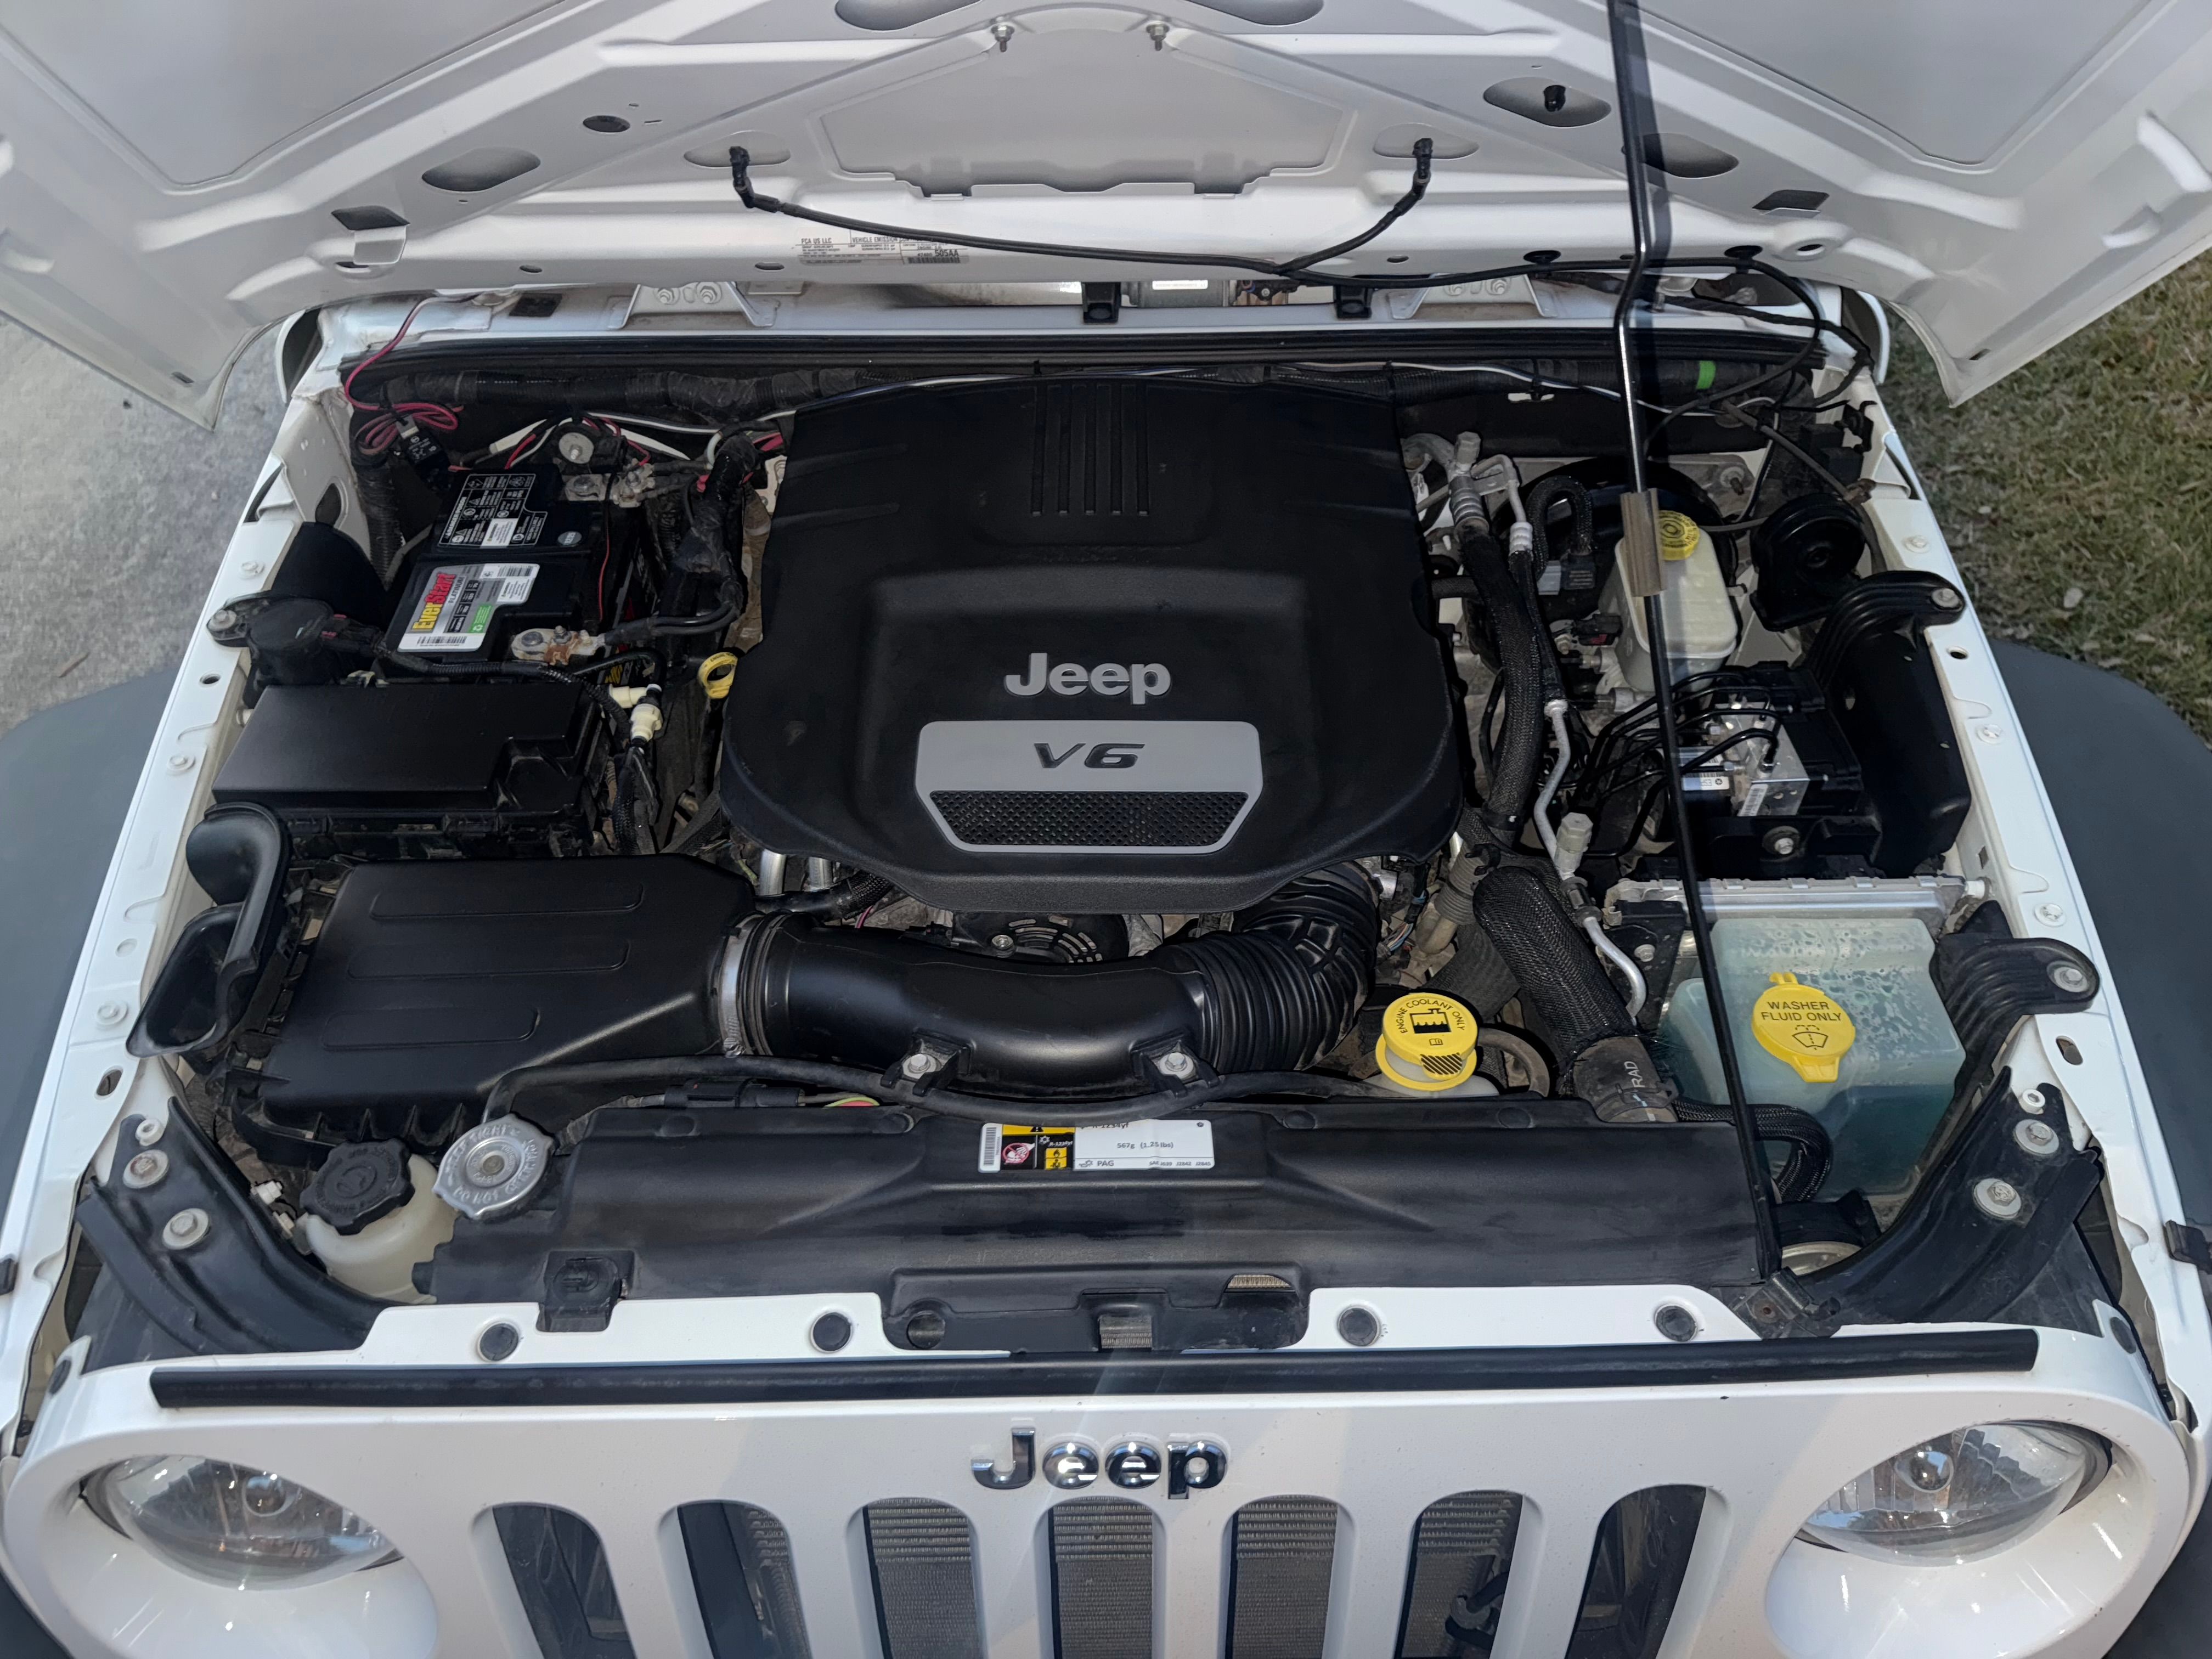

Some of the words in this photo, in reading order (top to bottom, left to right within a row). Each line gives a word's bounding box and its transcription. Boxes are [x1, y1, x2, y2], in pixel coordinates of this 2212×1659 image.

[412, 573, 456, 630] EverStart
[448, 577, 464, 603] PLATINUM
[1005, 652, 1172, 705] Jeep
[1034, 743, 1146, 769] V6
[1396, 1007, 1408, 1034] ENGINE
[1406, 999, 1453, 1011] COOLANT
[1452, 1011, 1466, 1031] ONLY
[1761, 1012, 1802, 1021] FLUID
[1807, 1012, 1841, 1022] ONLY
[1767, 1001, 1830, 1010] WASHER
[1624, 1061, 1645, 1087] RAD
[970, 1427, 1228, 1499] Jeep
